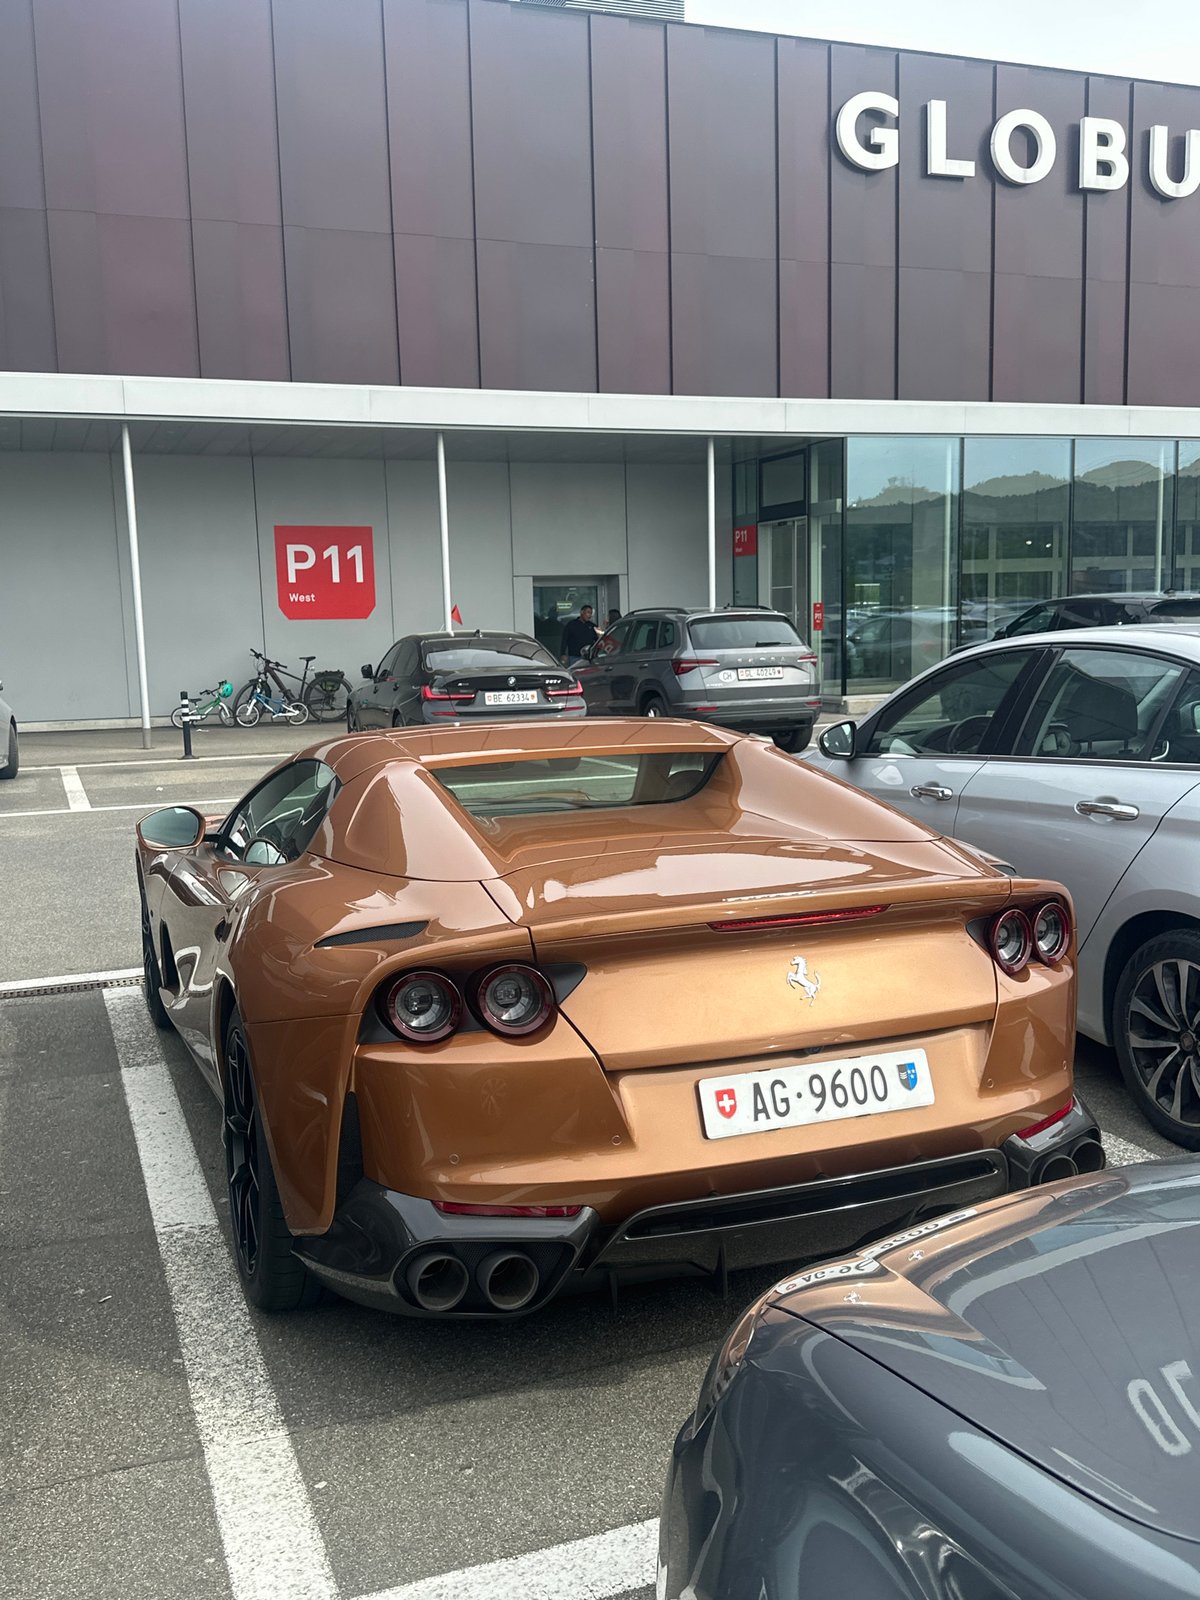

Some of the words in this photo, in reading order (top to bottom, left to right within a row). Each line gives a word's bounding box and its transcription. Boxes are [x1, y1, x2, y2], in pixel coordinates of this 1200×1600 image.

[836, 91, 1200, 198] GLOBU
[735, 529, 748, 544] P11
[286, 544, 364, 583] P11
[289, 592, 316, 602] West
